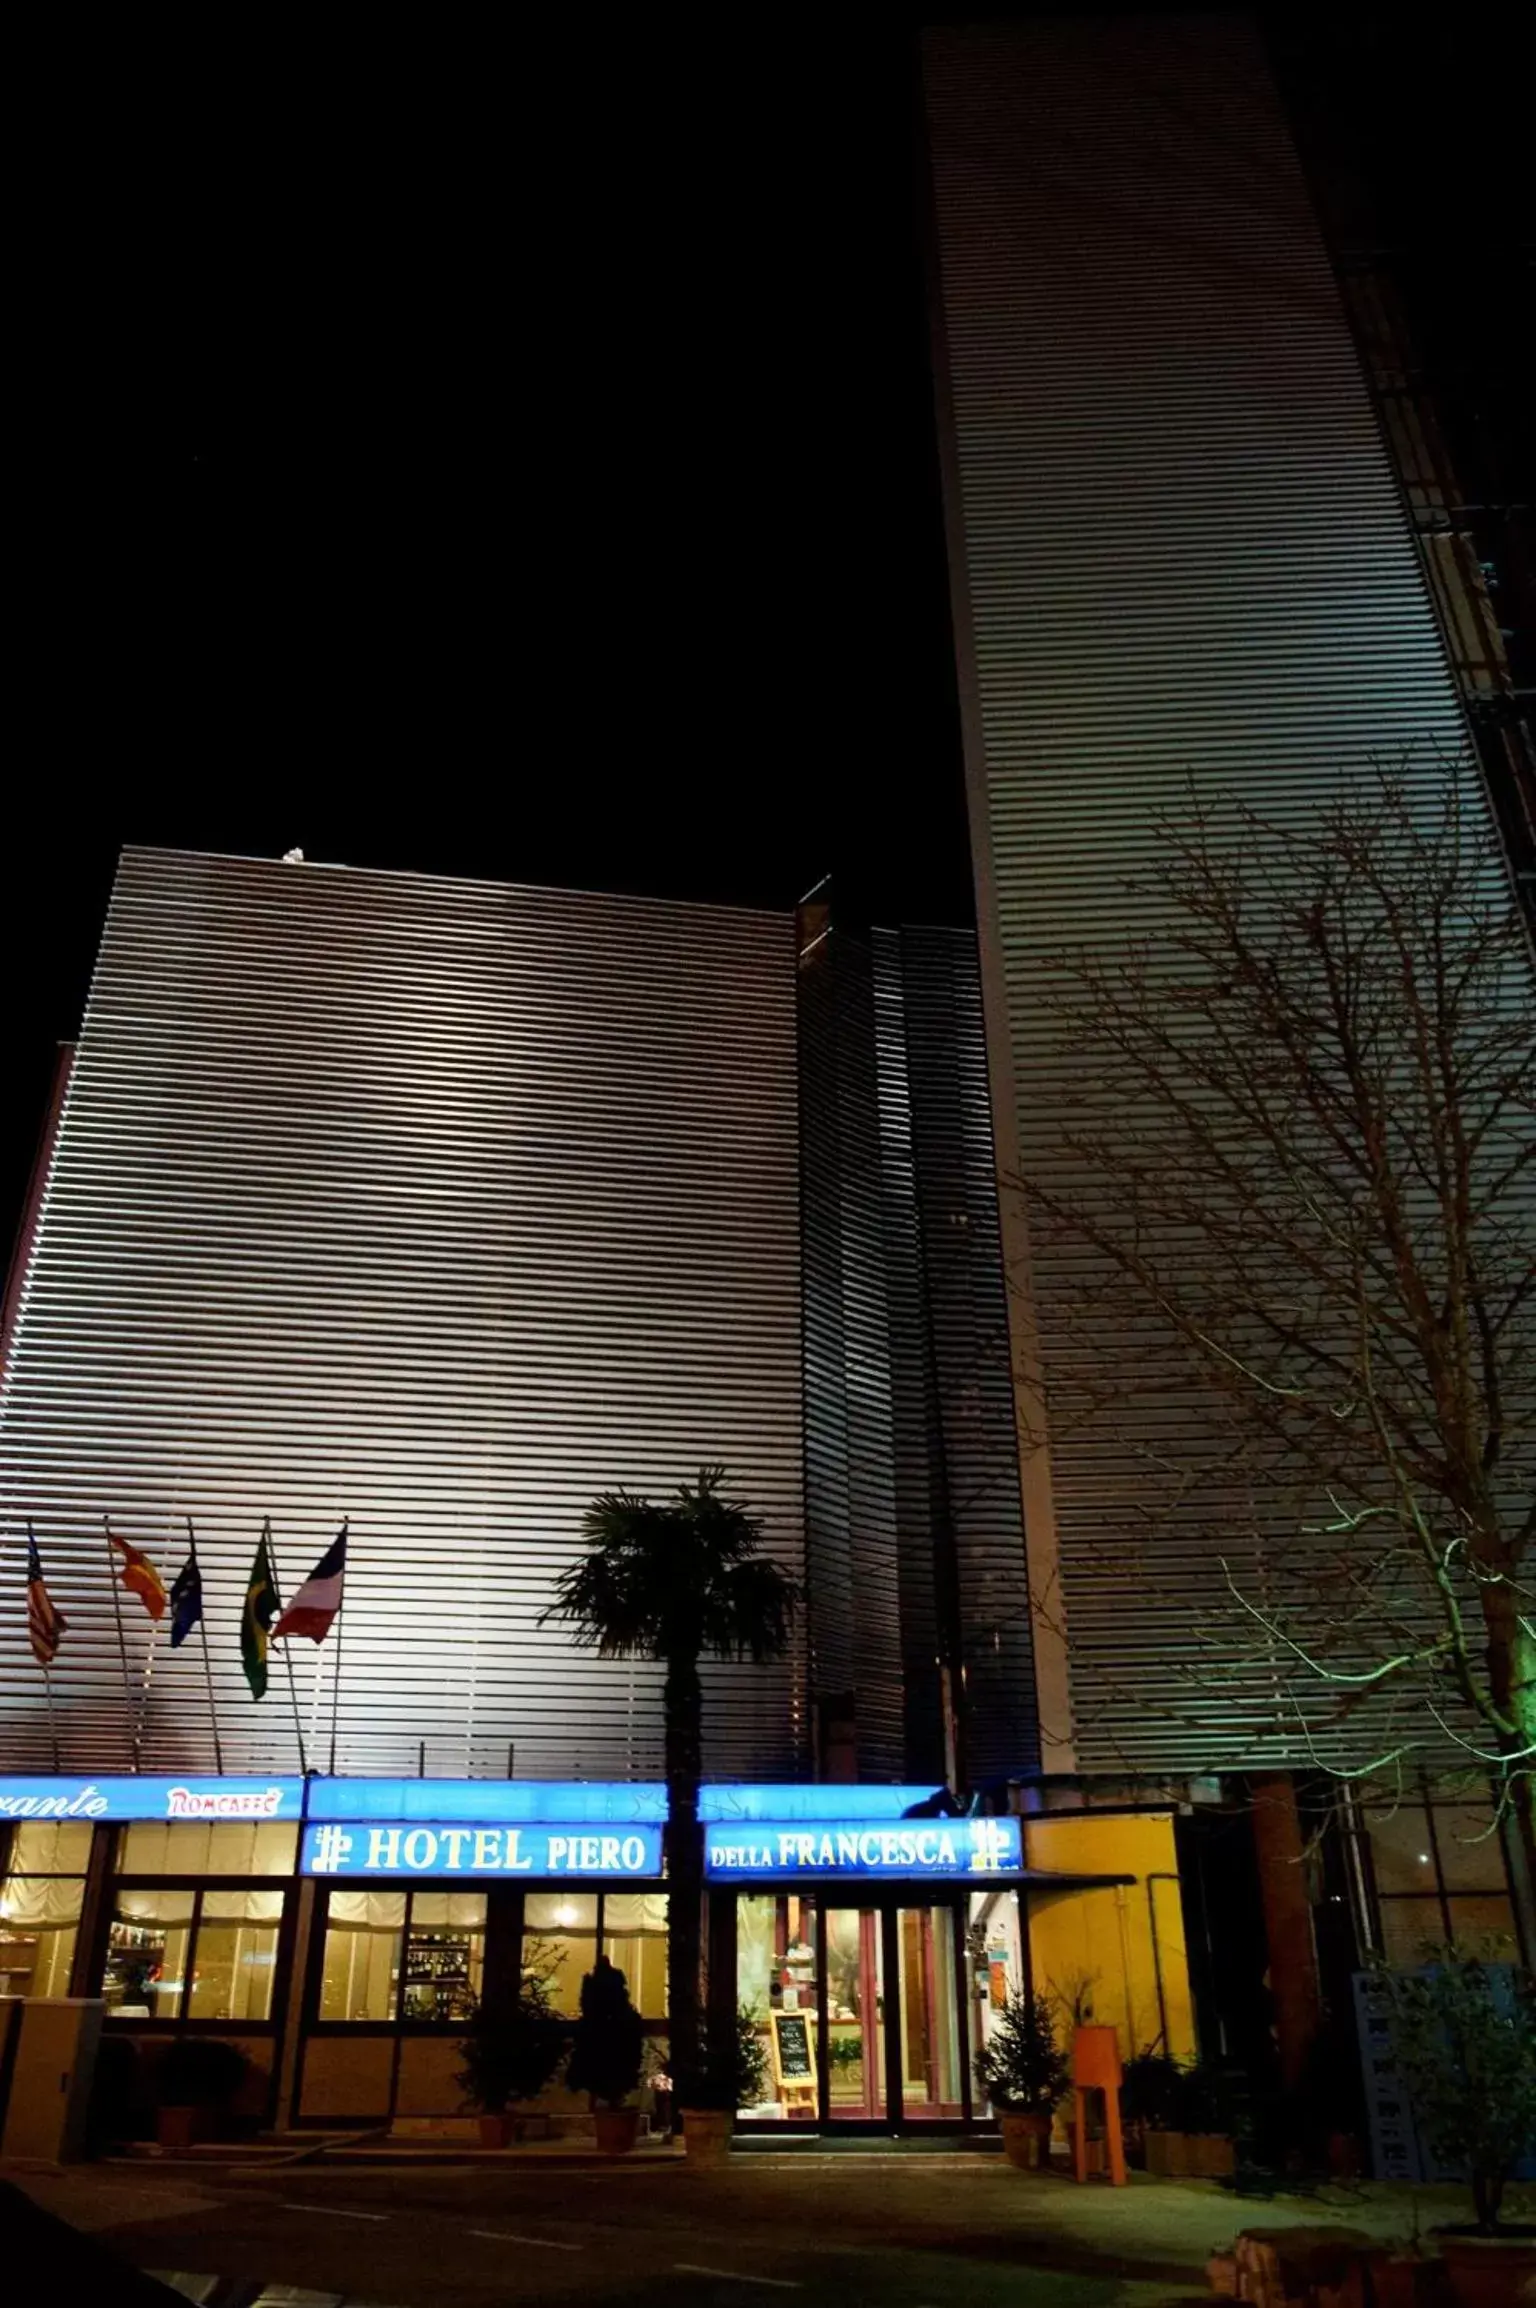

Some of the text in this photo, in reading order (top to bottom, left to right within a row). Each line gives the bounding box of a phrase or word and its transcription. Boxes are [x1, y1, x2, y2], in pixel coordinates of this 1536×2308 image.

[364, 1829, 646, 1870] HOTEL PIERO
[711, 1830, 957, 1867] DELLA FRANCESCA
